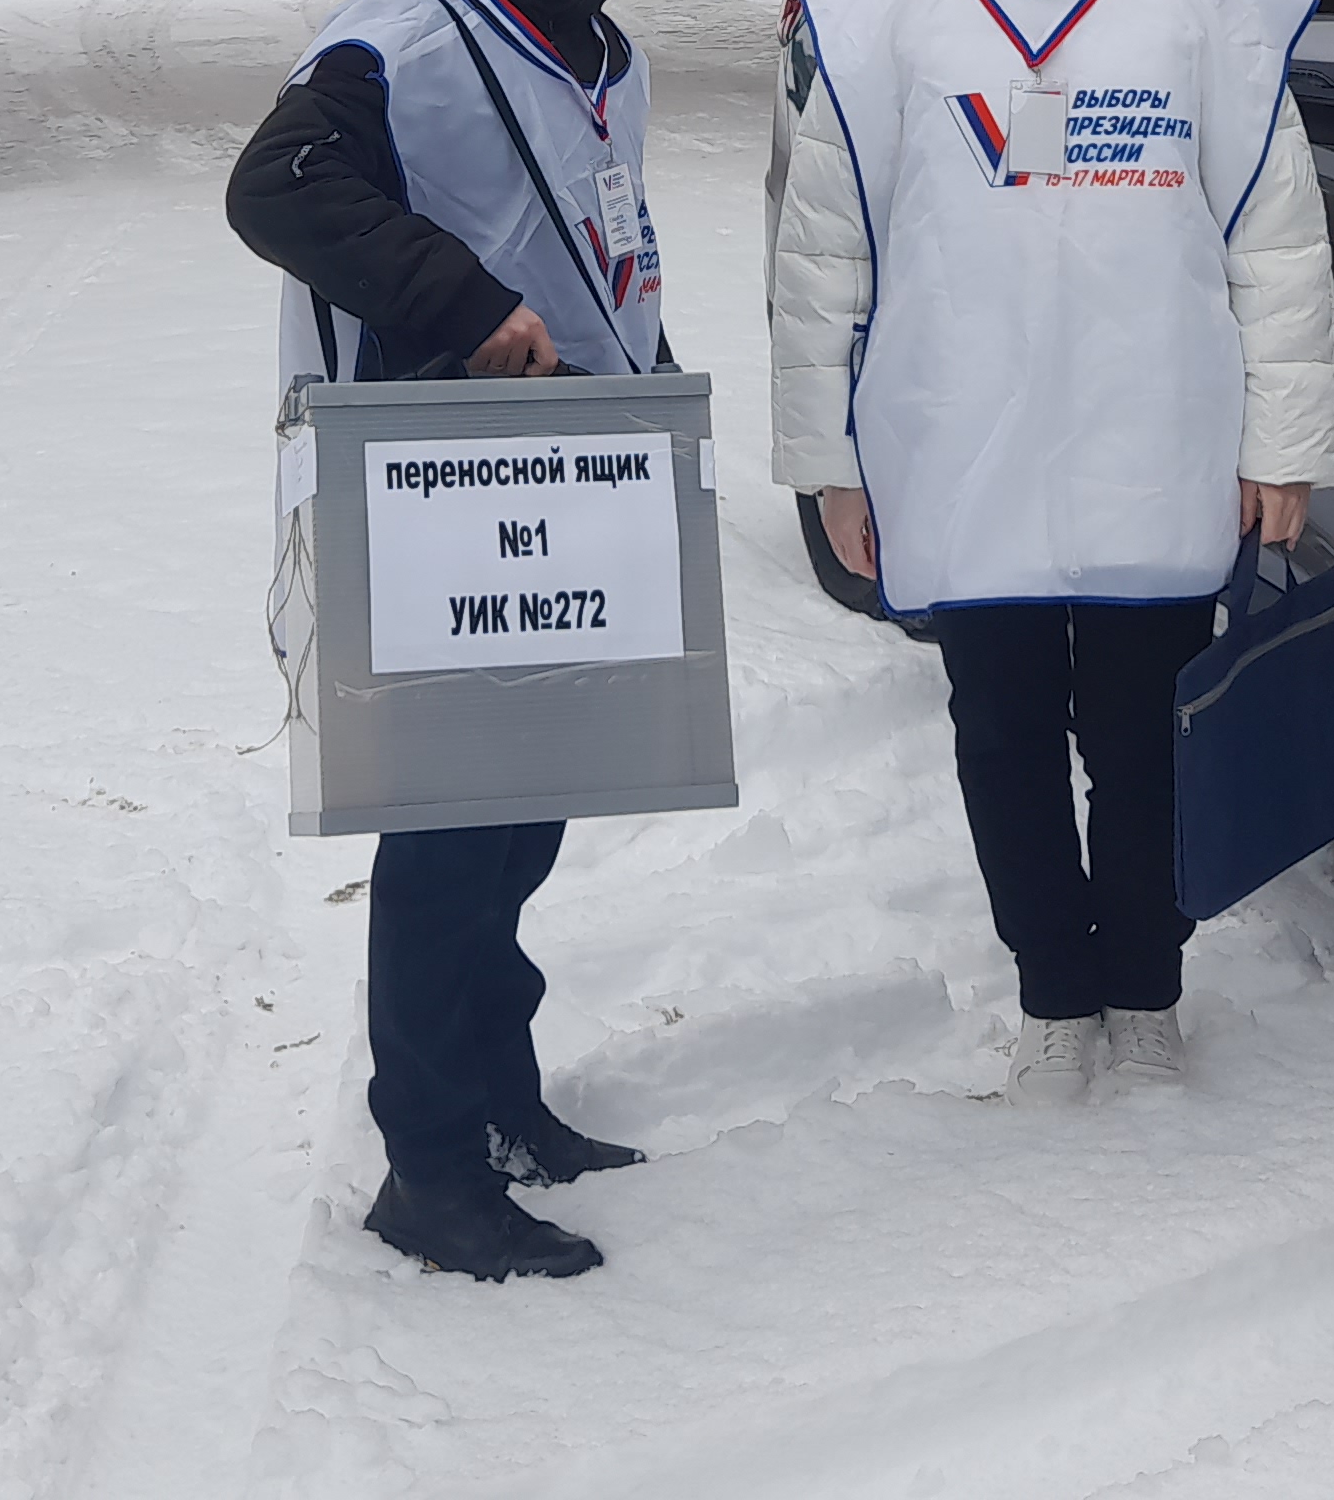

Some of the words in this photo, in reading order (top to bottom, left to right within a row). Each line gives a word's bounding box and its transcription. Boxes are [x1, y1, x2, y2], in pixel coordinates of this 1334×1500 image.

[1071, 89, 1171, 109] ВЫБОРЫ
[1064, 143, 1144, 163] ОССИИ
[1090, 169, 1146, 187] МАРТА
[1148, 170, 1186, 187] 2024
[386, 445, 566, 499] переносной
[575, 453, 651, 489] ящик
[498, 519, 549, 558] №1
[449, 594, 510, 636] УИК
[519, 589, 607, 633] №272
